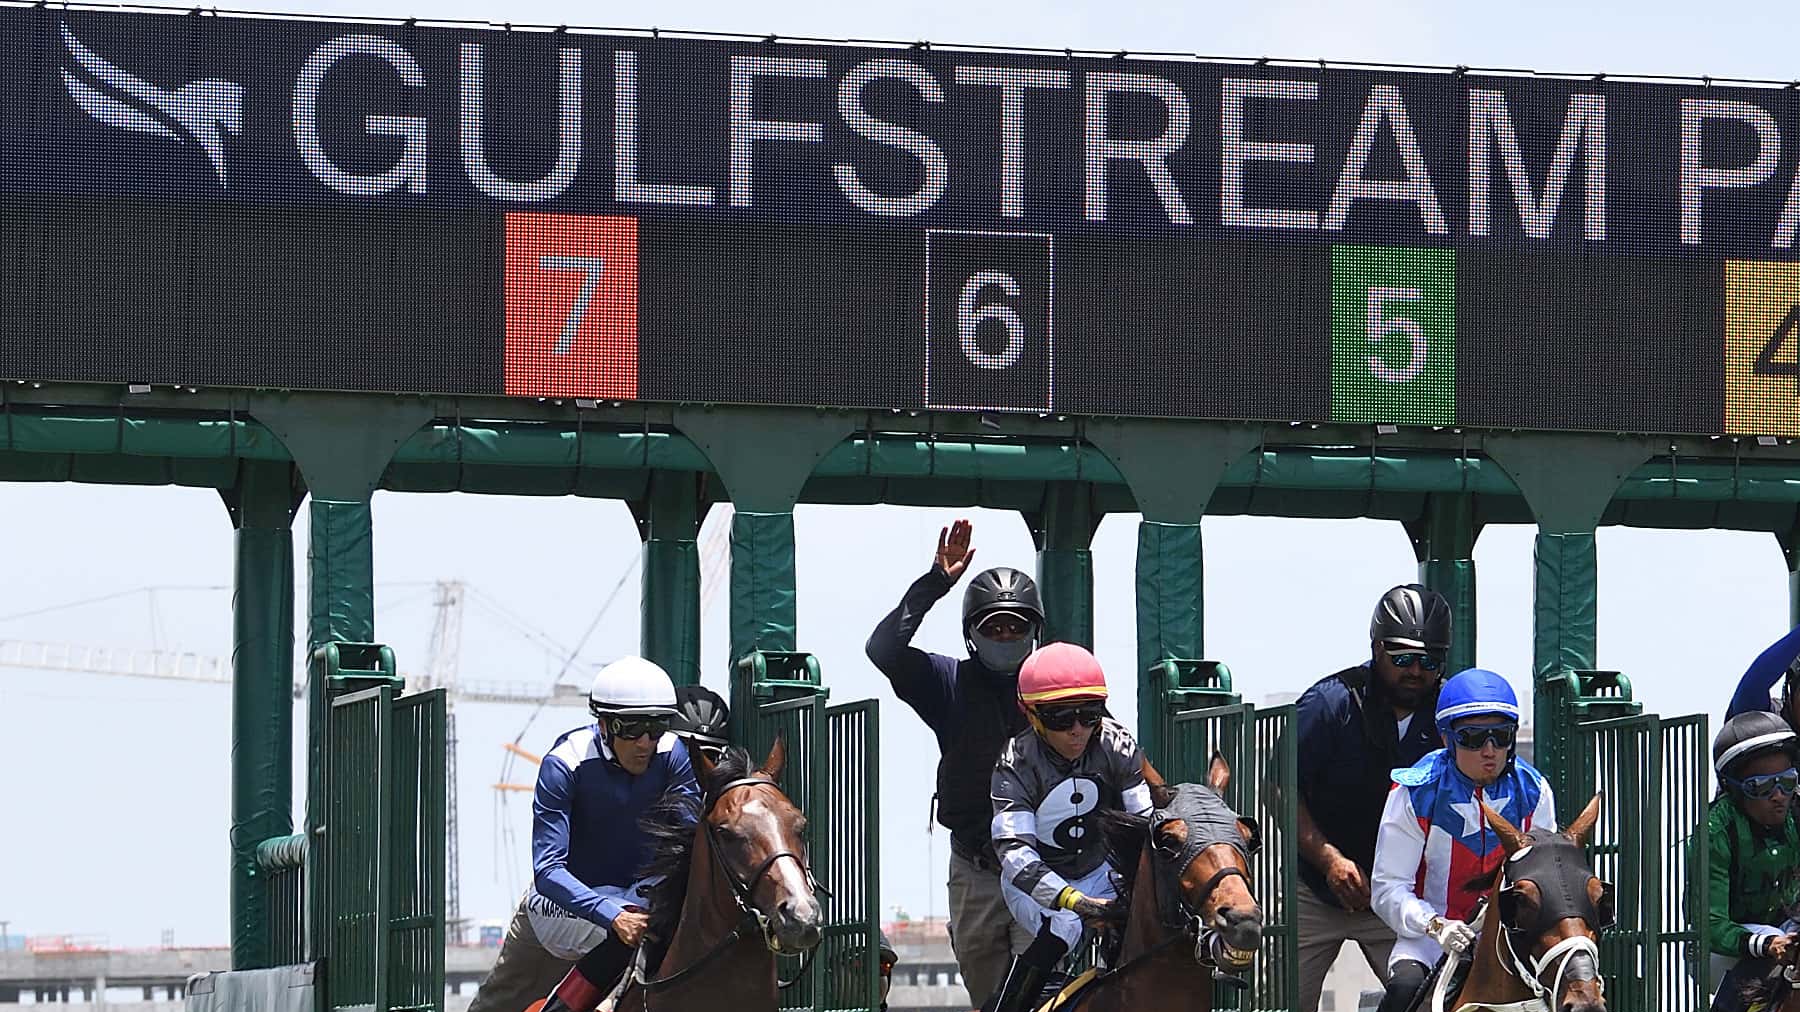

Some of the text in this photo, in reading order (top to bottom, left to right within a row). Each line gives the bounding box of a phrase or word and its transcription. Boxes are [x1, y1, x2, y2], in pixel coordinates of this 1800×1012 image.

[291, 33, 1607, 241] GULFSTREAM
[537, 255, 605, 356] 7
[957, 270, 1026, 370] 6
[1365, 285, 1429, 384] 5
